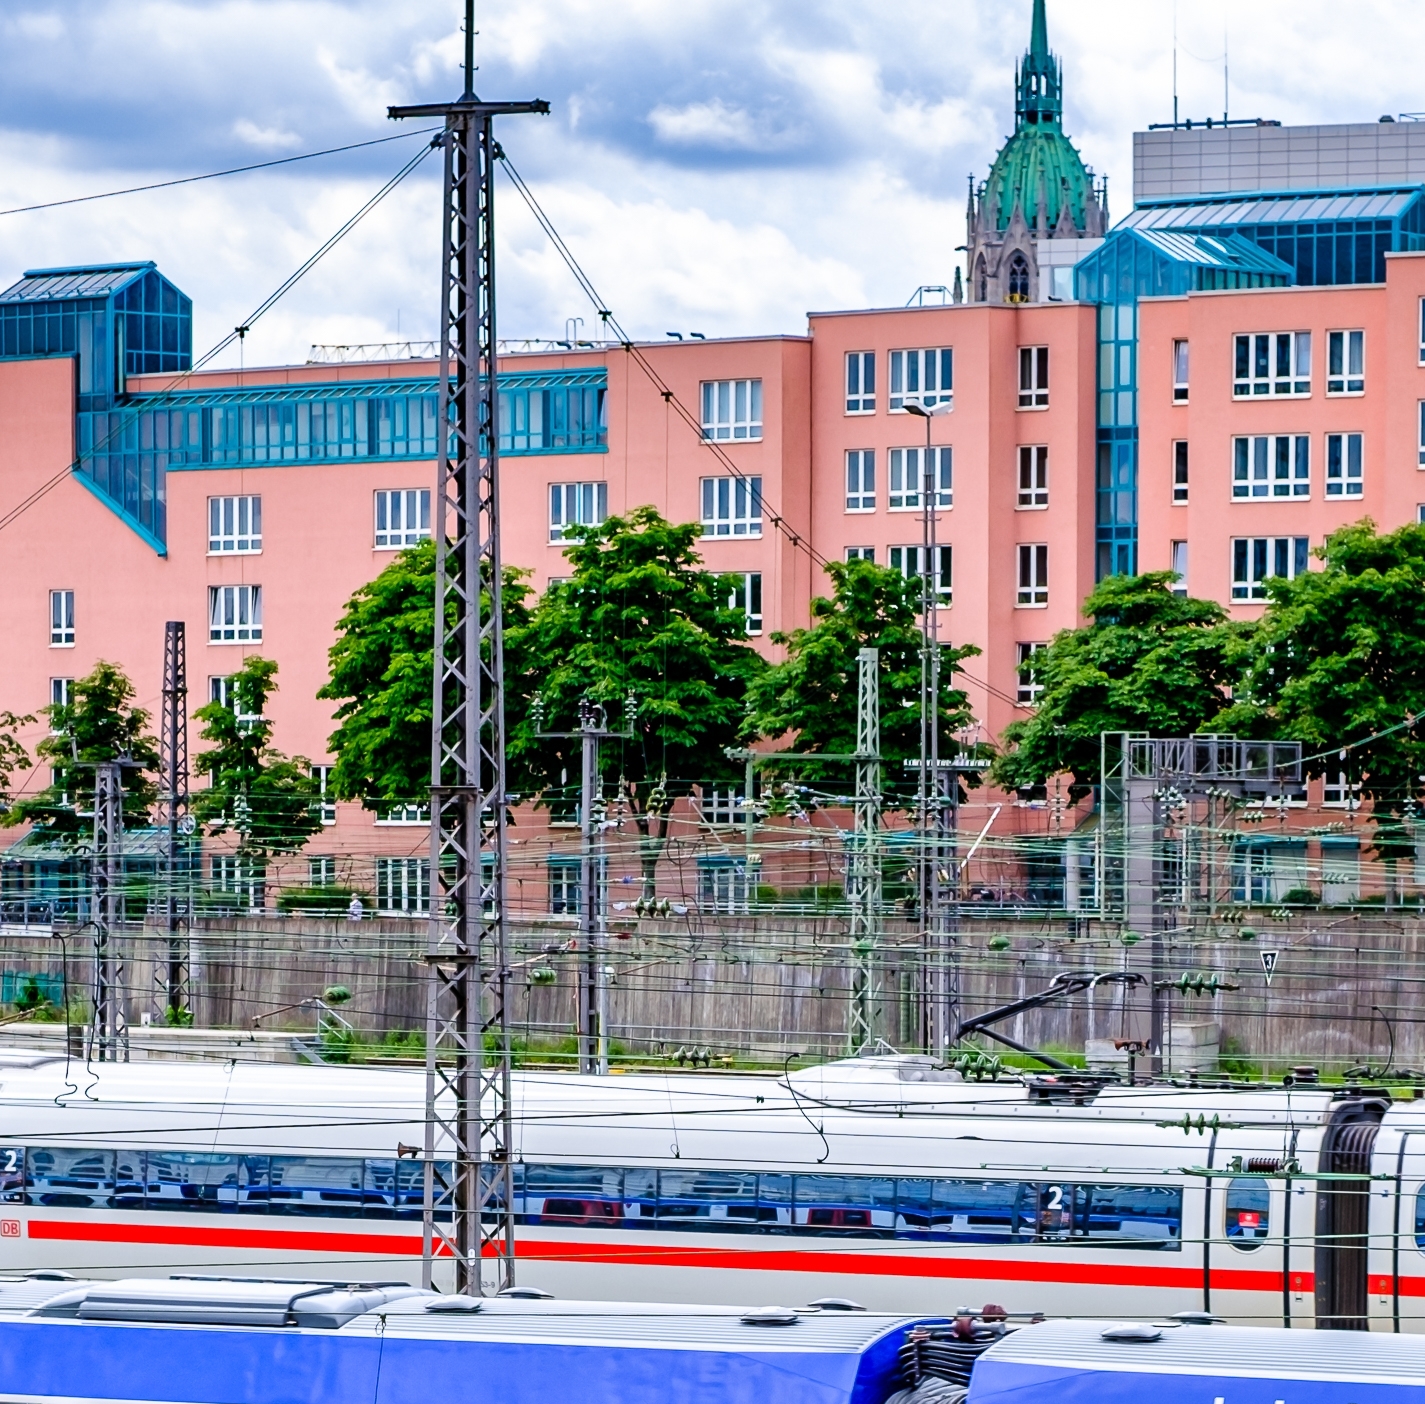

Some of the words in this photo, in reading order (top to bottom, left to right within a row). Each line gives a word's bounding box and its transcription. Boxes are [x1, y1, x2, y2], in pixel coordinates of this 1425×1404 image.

[1266, 955, 1272, 969] 3
[5, 1151, 17, 1172] 2
[1048, 1186, 1063, 1210] 2
[1, 1221, 18, 1236] DB
